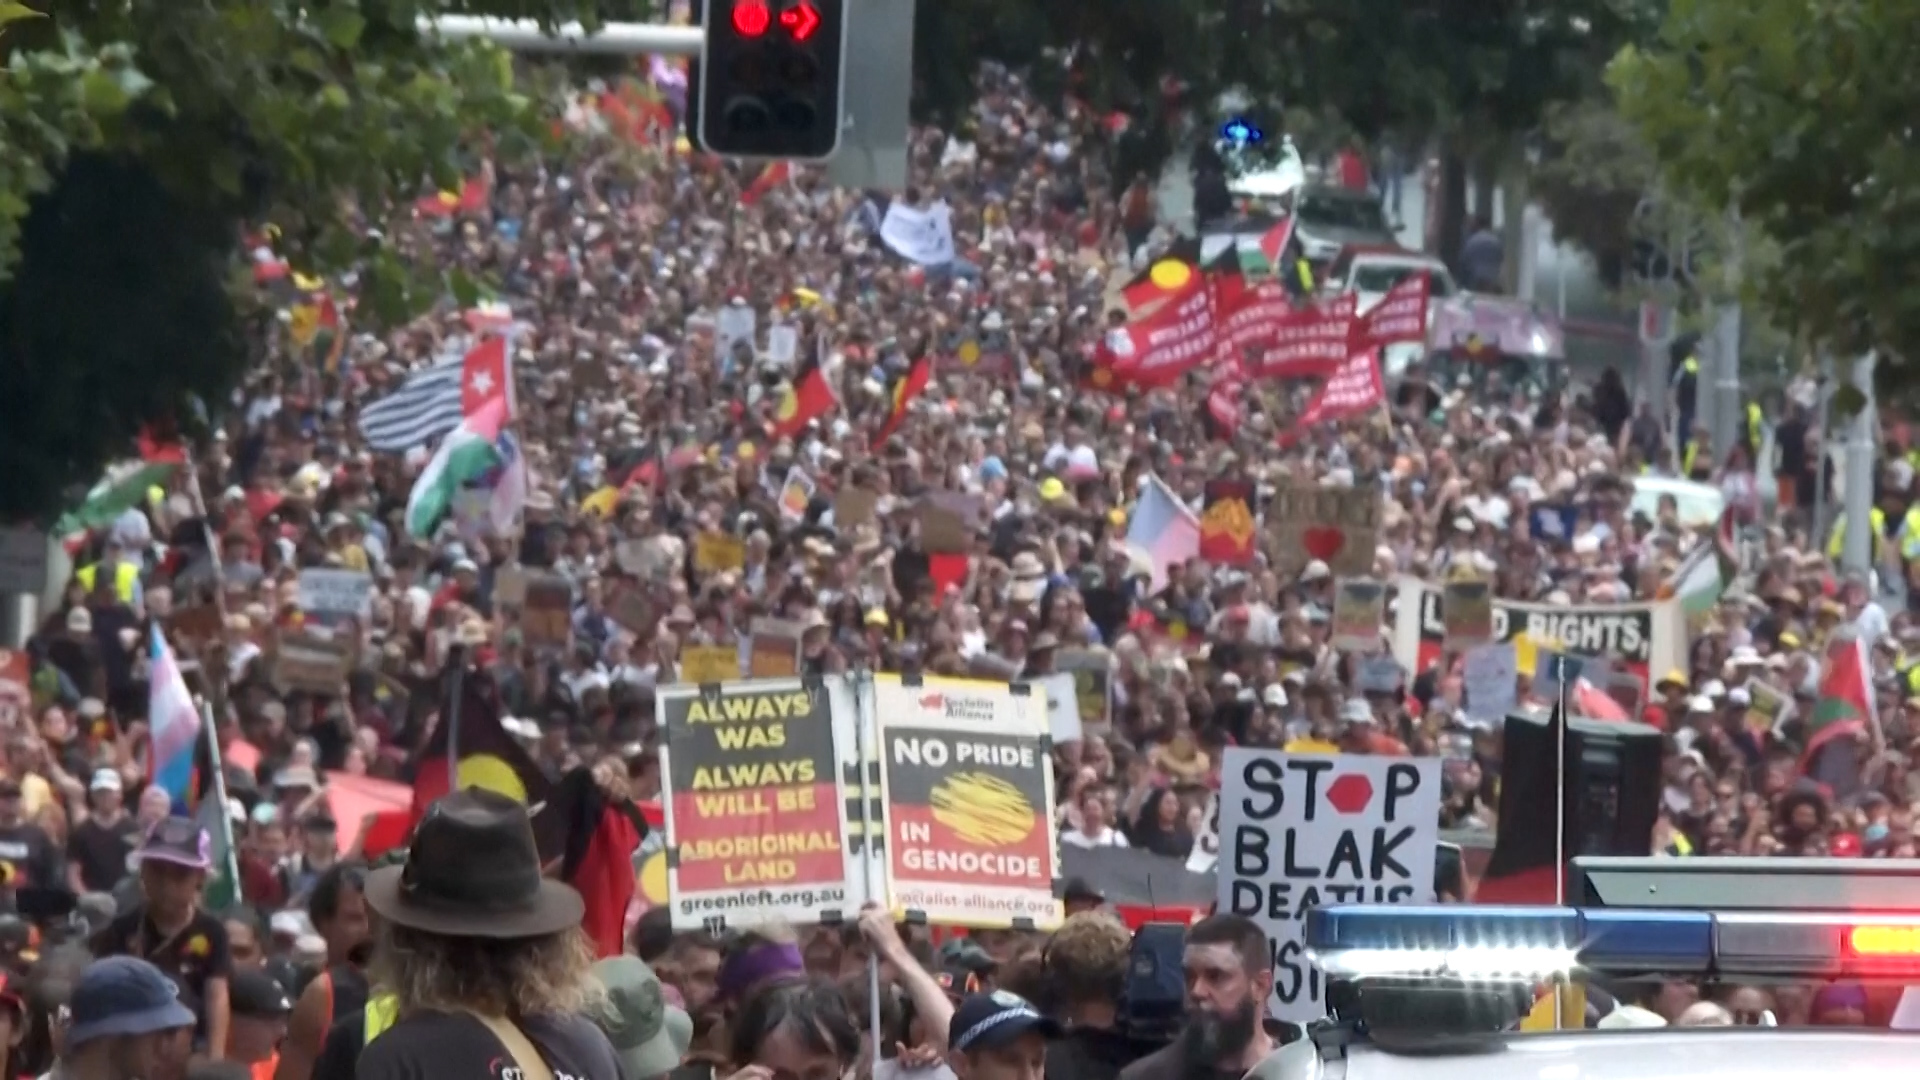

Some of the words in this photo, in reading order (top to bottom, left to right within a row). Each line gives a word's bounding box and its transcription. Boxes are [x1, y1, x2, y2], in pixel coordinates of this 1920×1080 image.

[1424, 595, 1509, 639] LD
[1527, 610, 1648, 660] RIGHTS,
[686, 692, 811, 724] ALWAYS
[945, 697, 994, 709] Socialist
[945, 708, 994, 720] Alliance
[714, 723, 786, 751] WAS
[894, 737, 949, 767] NO
[955, 741, 1034, 769] PRIDE
[692, 758, 816, 789] ALWAYS
[695, 791, 772, 819] WILL
[777, 786, 816, 812] BE
[679, 830, 841, 861] ABORIGINAL
[900, 820, 931, 843] IN
[902, 848, 1042, 878] GENOCIDE
[1234, 825, 1416, 880] BLAK
[723, 859, 797, 884] LAND
[680, 888, 845, 915] greenleft.org.au
[896, 891, 1055, 917] ocialist-allianceorg
